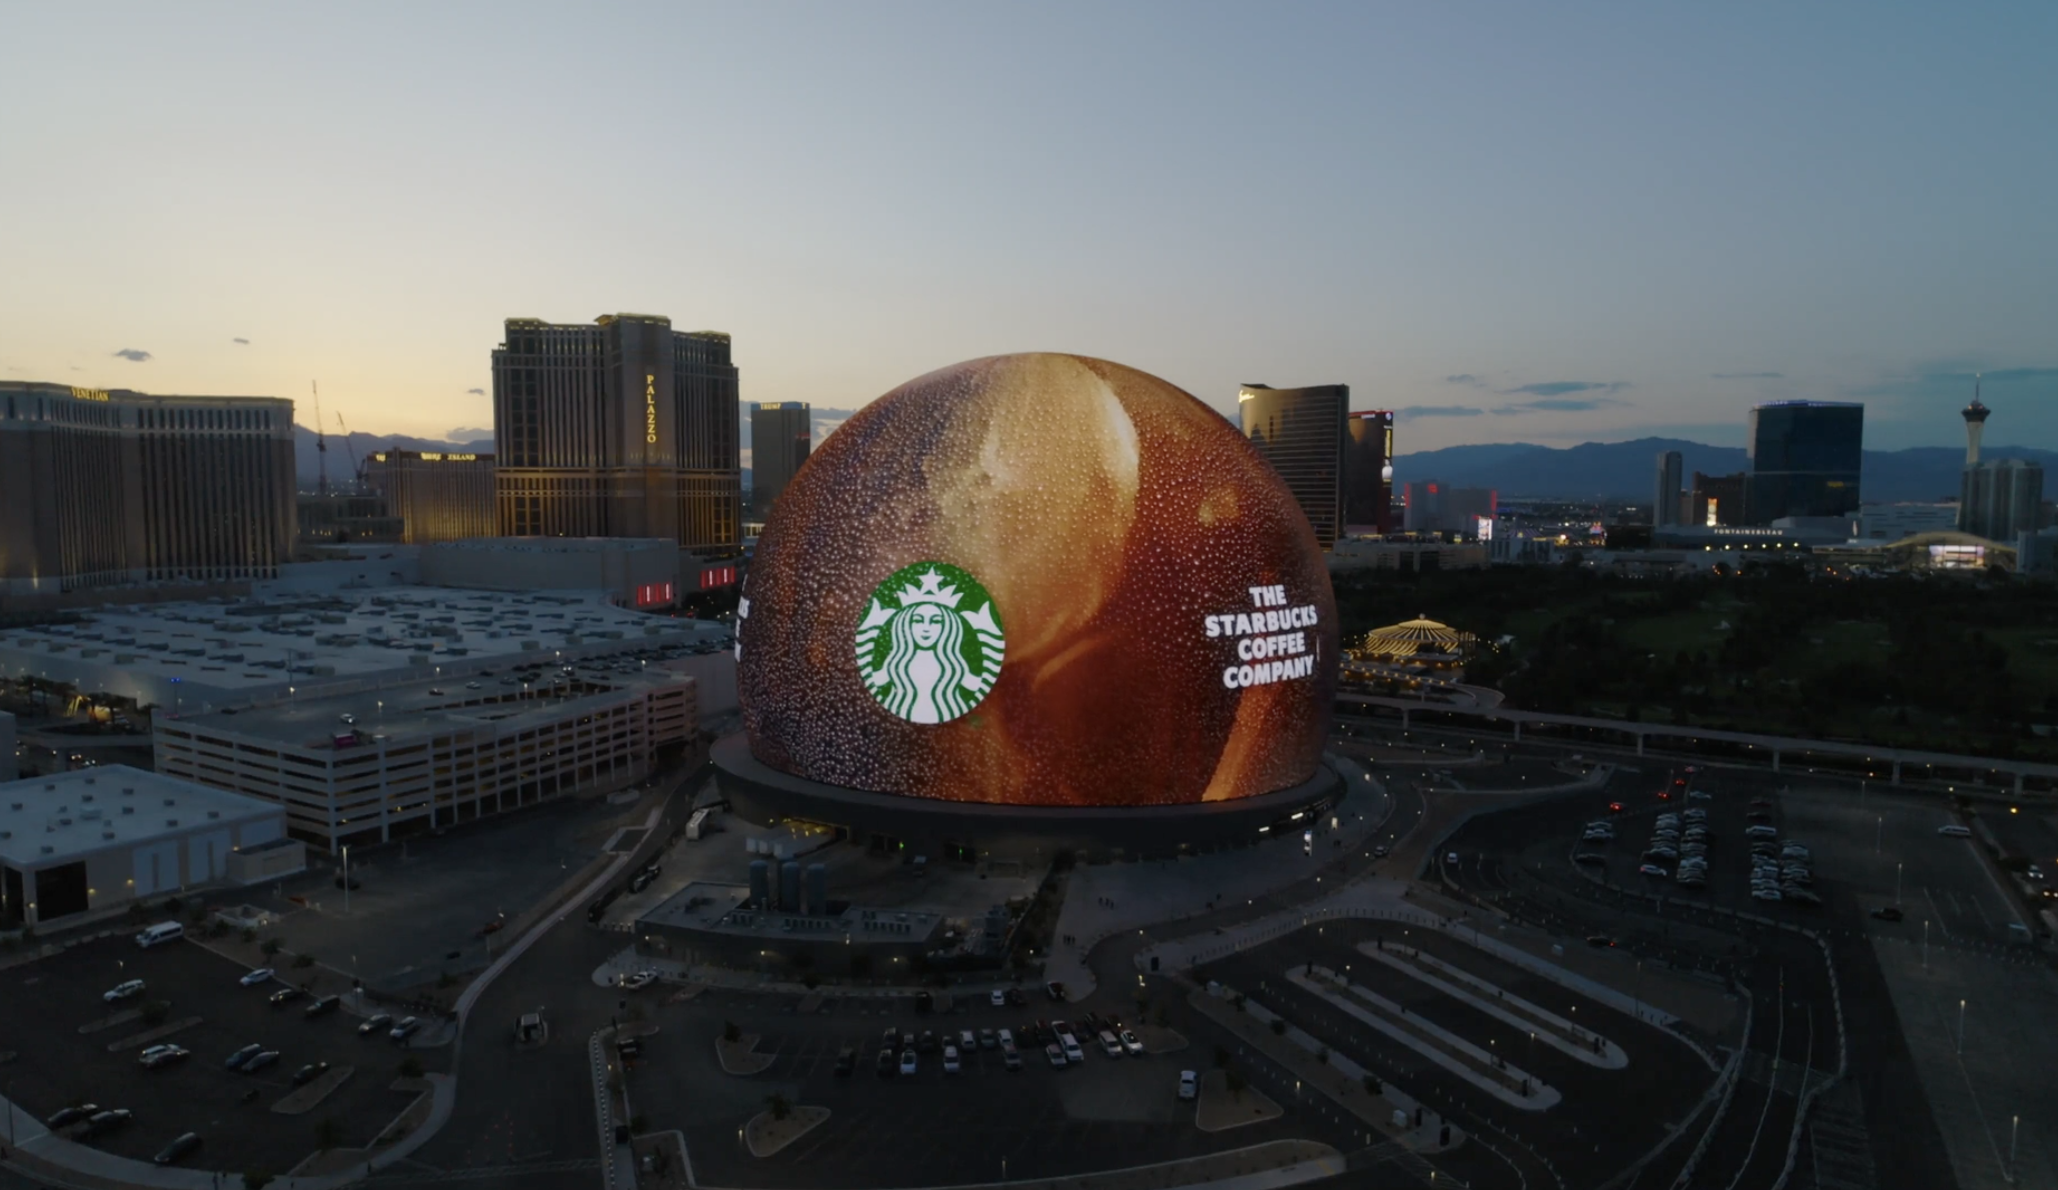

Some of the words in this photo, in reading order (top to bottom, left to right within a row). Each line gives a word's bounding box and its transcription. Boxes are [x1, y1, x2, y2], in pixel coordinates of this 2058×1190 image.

[71, 387, 109, 401] VENETIAN
[646, 374, 656, 443] PALAZZO
[1714, 528, 1783, 536] FONTAINEBLEAU
[1248, 584, 1287, 608] THE
[1204, 604, 1318, 638] STARBUCKS
[1237, 631, 1306, 661] COFFEE
[1223, 654, 1314, 689] COMPANY
